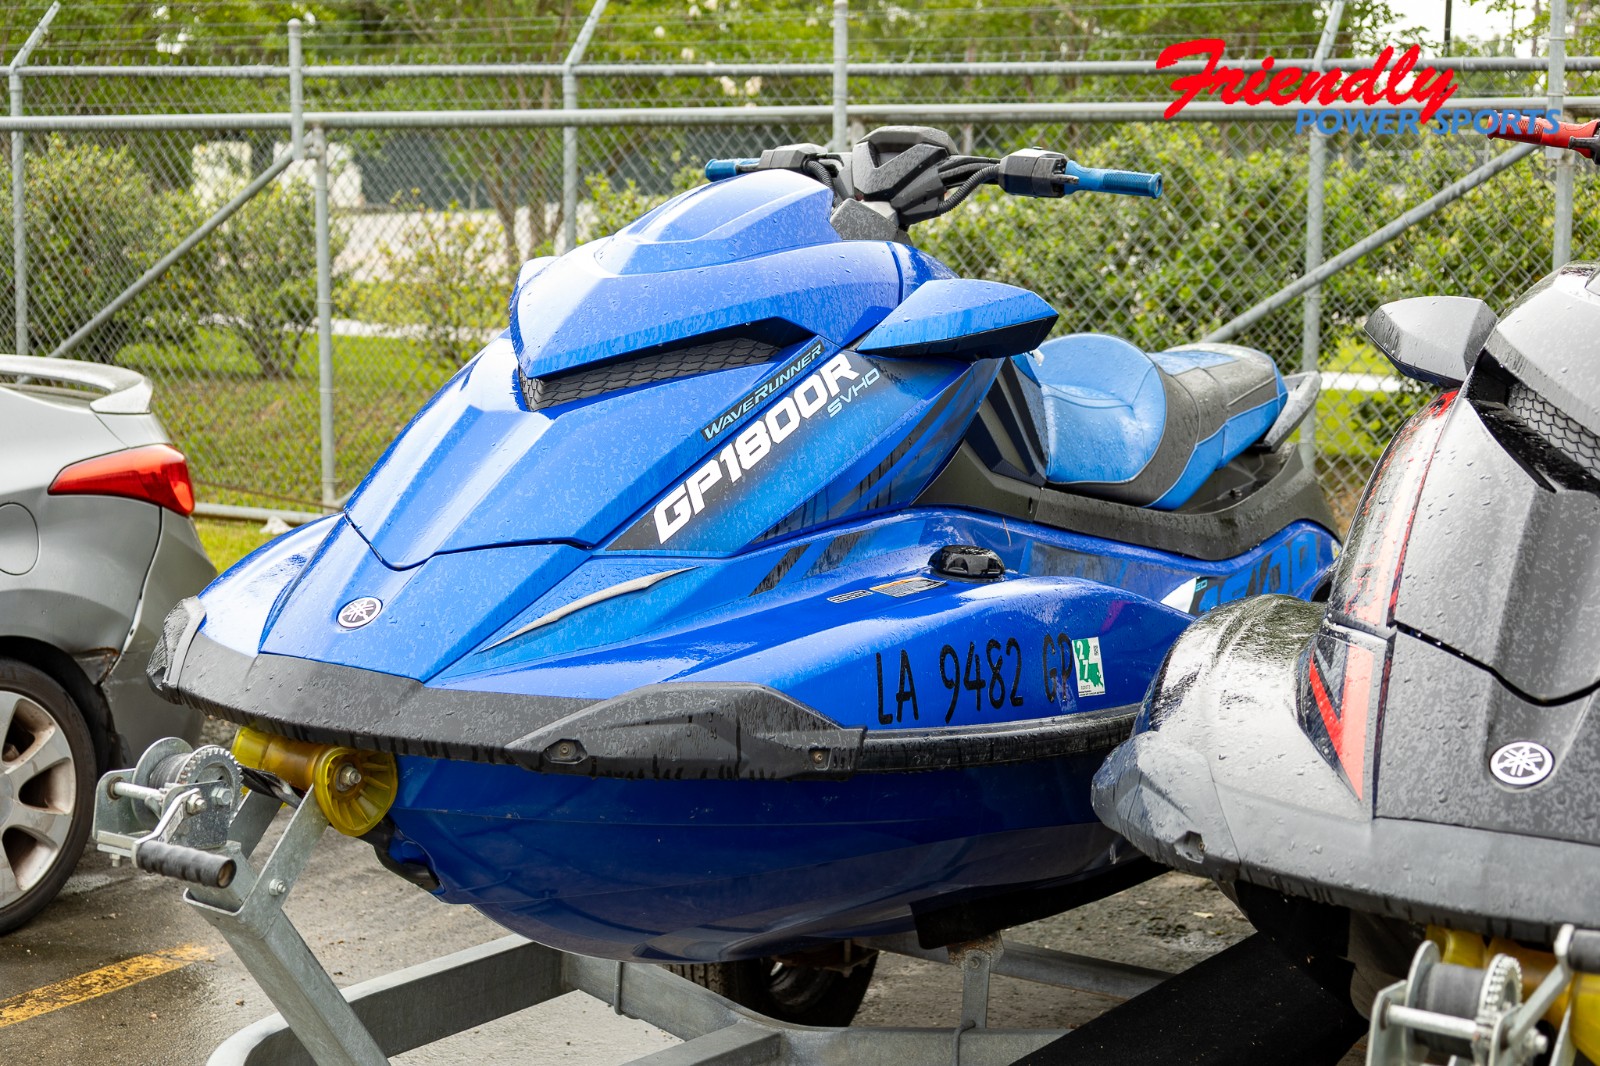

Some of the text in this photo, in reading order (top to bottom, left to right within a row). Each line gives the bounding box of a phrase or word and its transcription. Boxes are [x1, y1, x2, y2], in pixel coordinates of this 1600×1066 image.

[827, 367, 881, 418] SVHO
[653, 353, 860, 545] GP1800R
[876, 649, 919, 725] LA
[939, 637, 1024, 724] 9482
